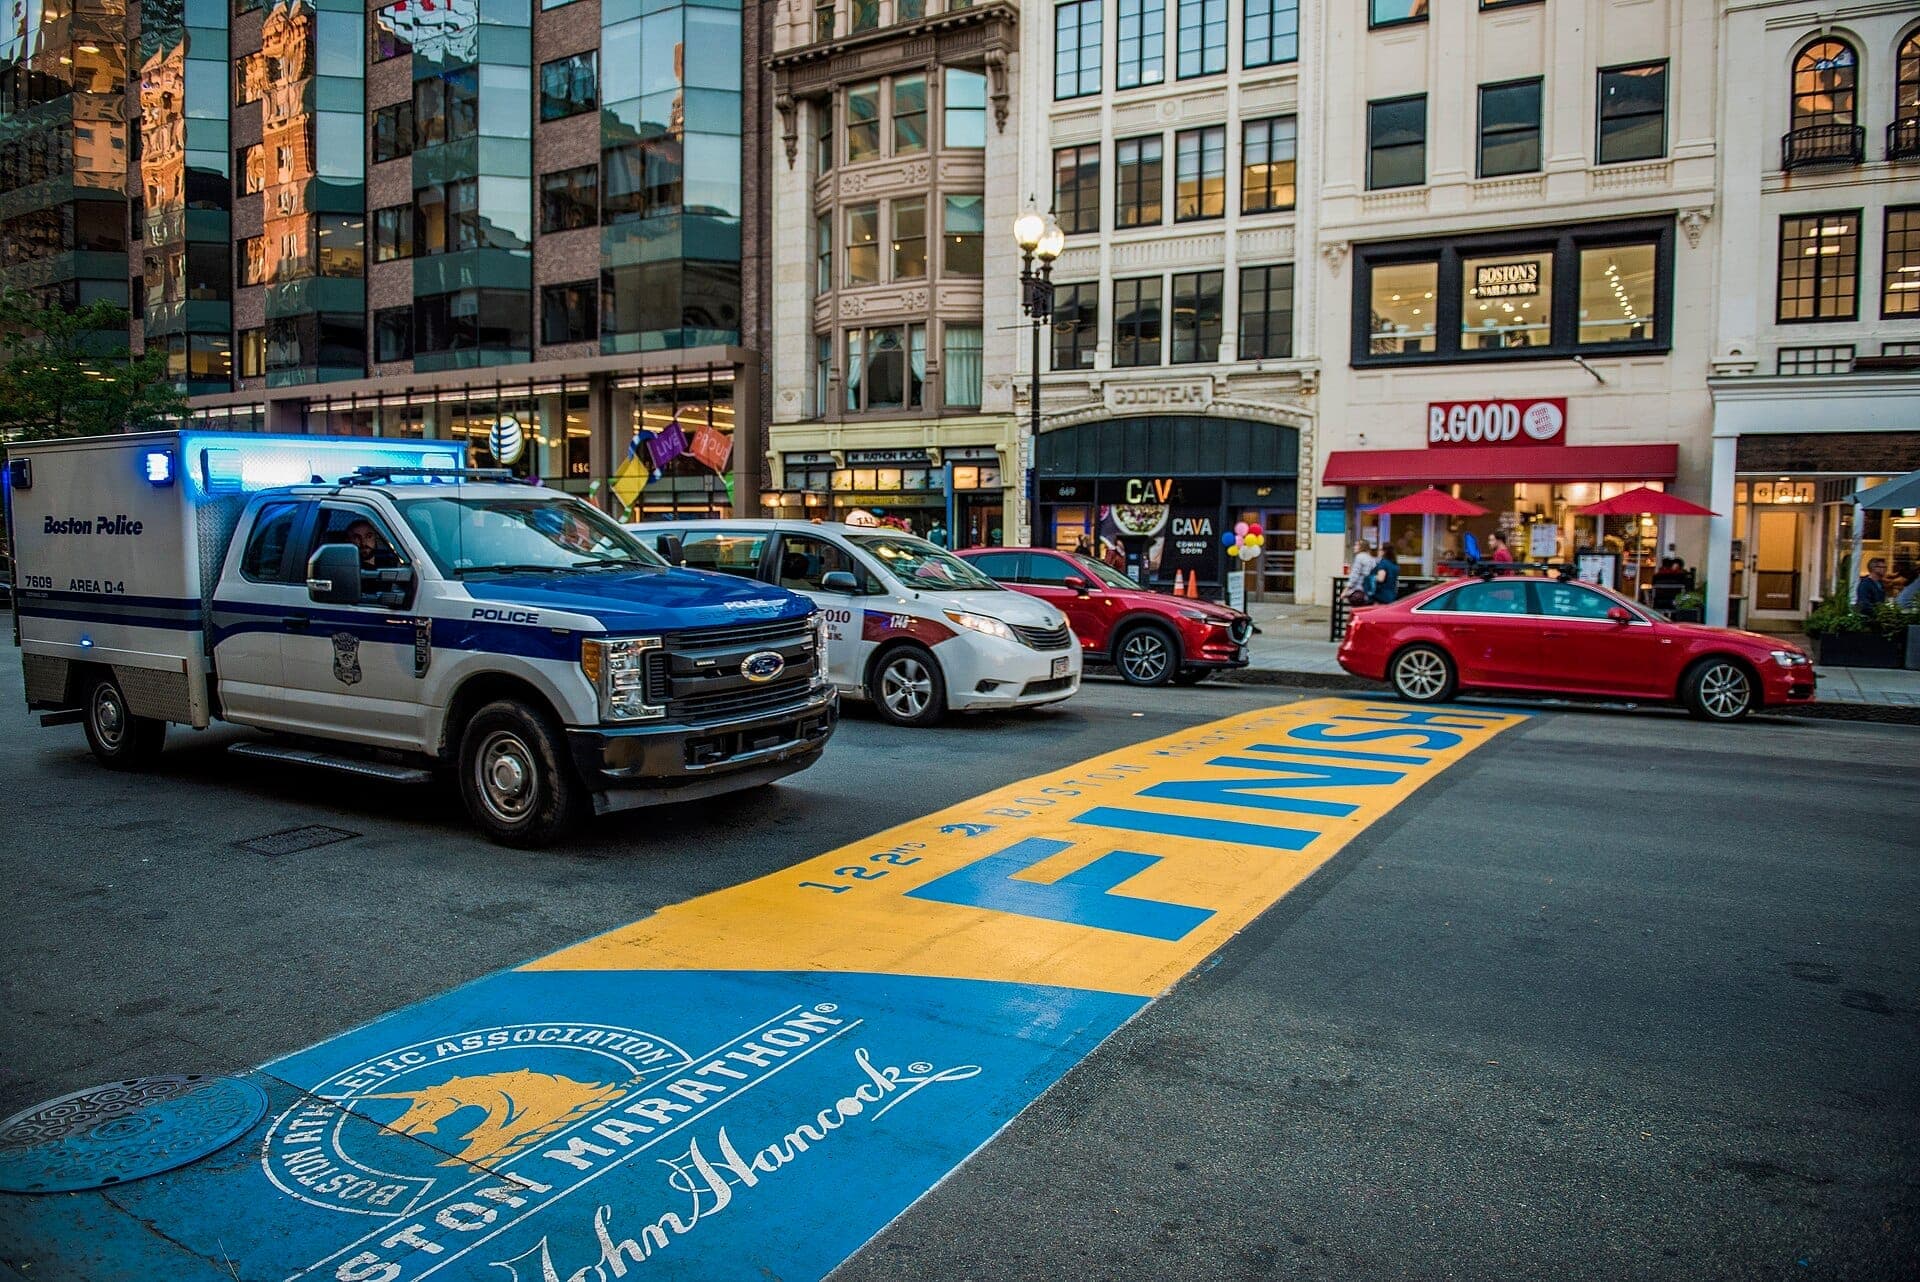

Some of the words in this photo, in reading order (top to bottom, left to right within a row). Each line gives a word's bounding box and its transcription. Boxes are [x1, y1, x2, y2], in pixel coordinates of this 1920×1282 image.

[1114, 384, 1205, 405] GOODYEAR
[1429, 403, 1521, 442] B.GOOD
[656, 431, 680, 457] LIVE
[696, 430, 728, 461] PROUD
[899, 449, 928, 461] PLACE
[1126, 479, 1174, 504] CAV
[44, 515, 92, 535] Boston
[96, 514, 143, 536] Police
[1172, 518, 1213, 536] CAVA
[1175, 541, 1207, 549] COMING
[25, 575, 52, 588] 7609
[69, 578, 101, 592] AREA
[723, 598, 768, 610] POLICE
[471, 607, 540, 624] POLICE
[821, 609, 851, 623] 010
[986, 762, 1151, 819] BOSTON
[904, 707, 1505, 942] FINISH
[281, 1146, 409, 1206] BOSTON
[435, 1027, 674, 1065] ASSOCIATION
